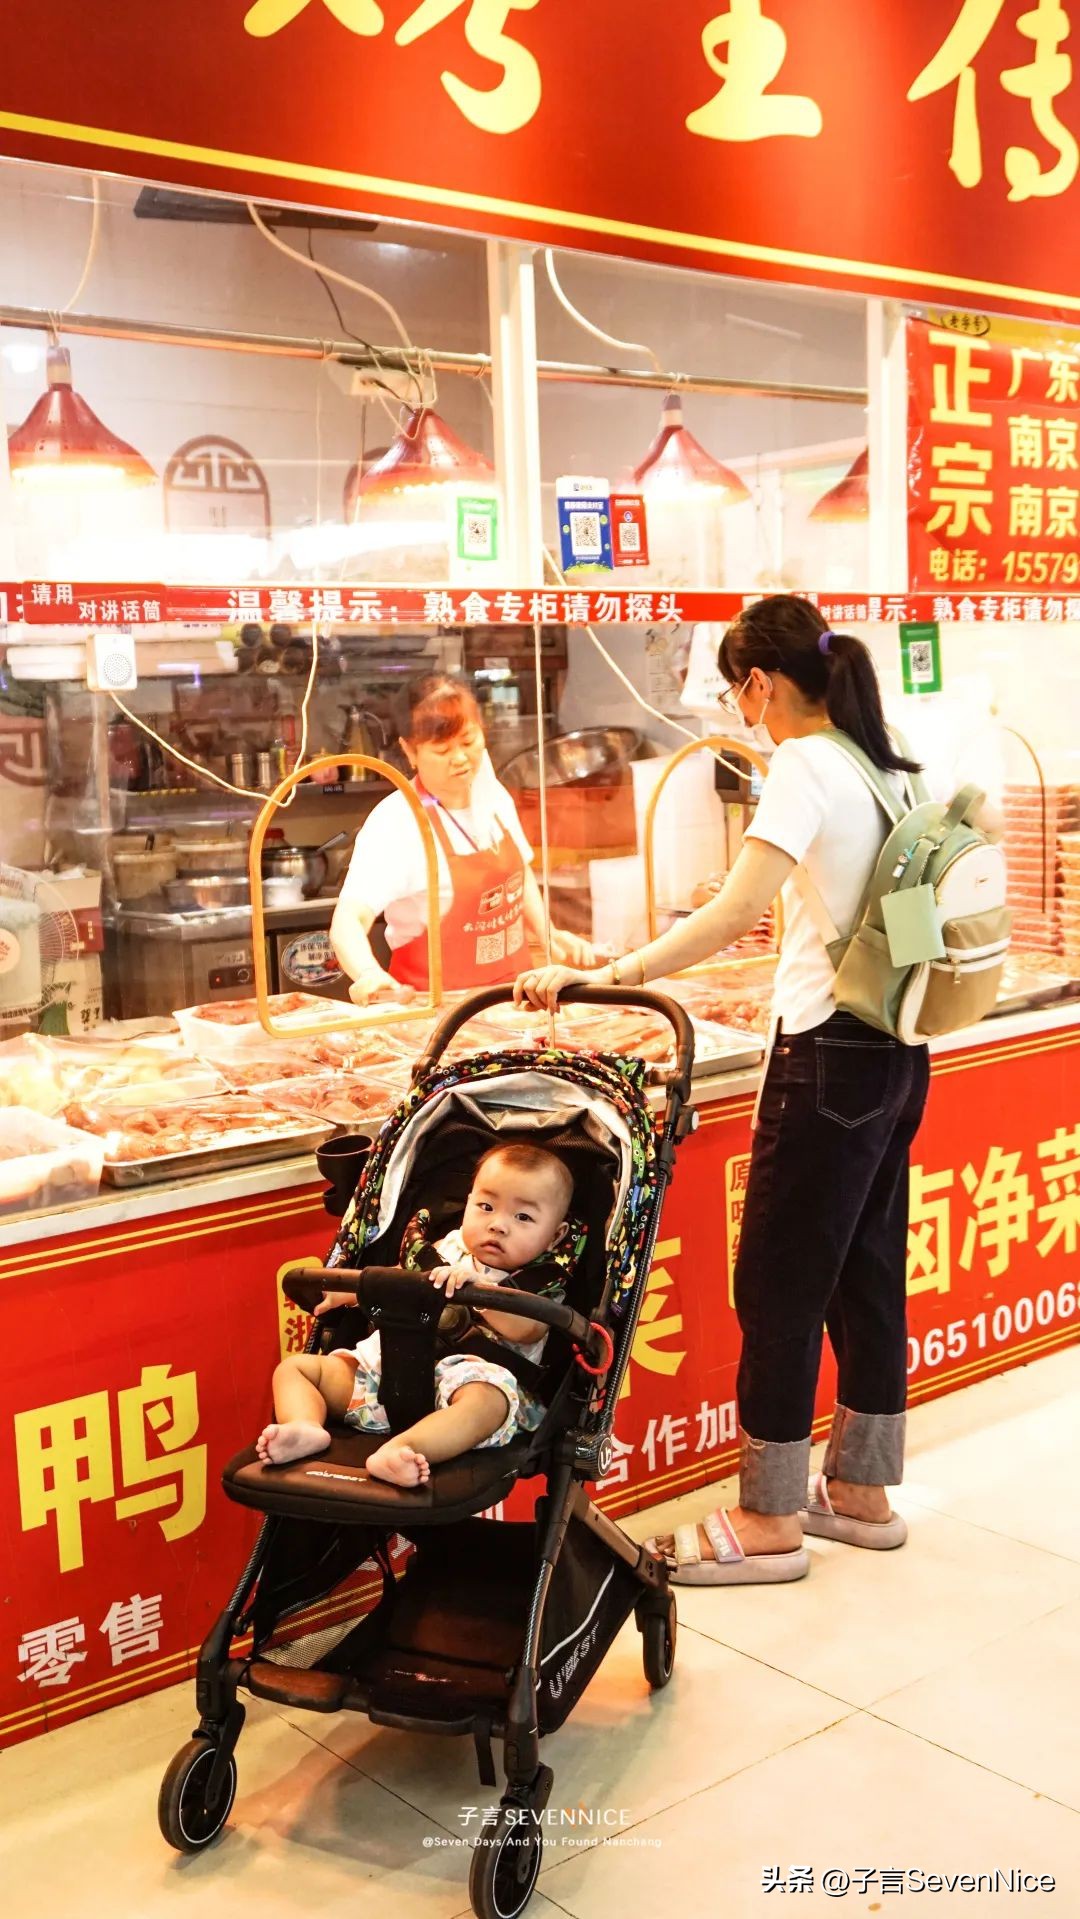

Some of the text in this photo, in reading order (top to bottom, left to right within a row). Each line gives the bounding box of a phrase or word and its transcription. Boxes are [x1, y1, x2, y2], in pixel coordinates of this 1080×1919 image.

[1008, 347, 1080, 402] 广东
[926, 330, 994, 538] 正宗
[1008, 414, 1080, 471] 南京
[1008, 484, 1080, 538] 南京
[31, 583, 73, 605] 请用
[78, 600, 161, 622] 对讲话筒
[907, 1282, 1080, 1374] 06510006
[14, 1364, 207, 1574] 鸭
[17, 1593, 164, 1688] 零售
